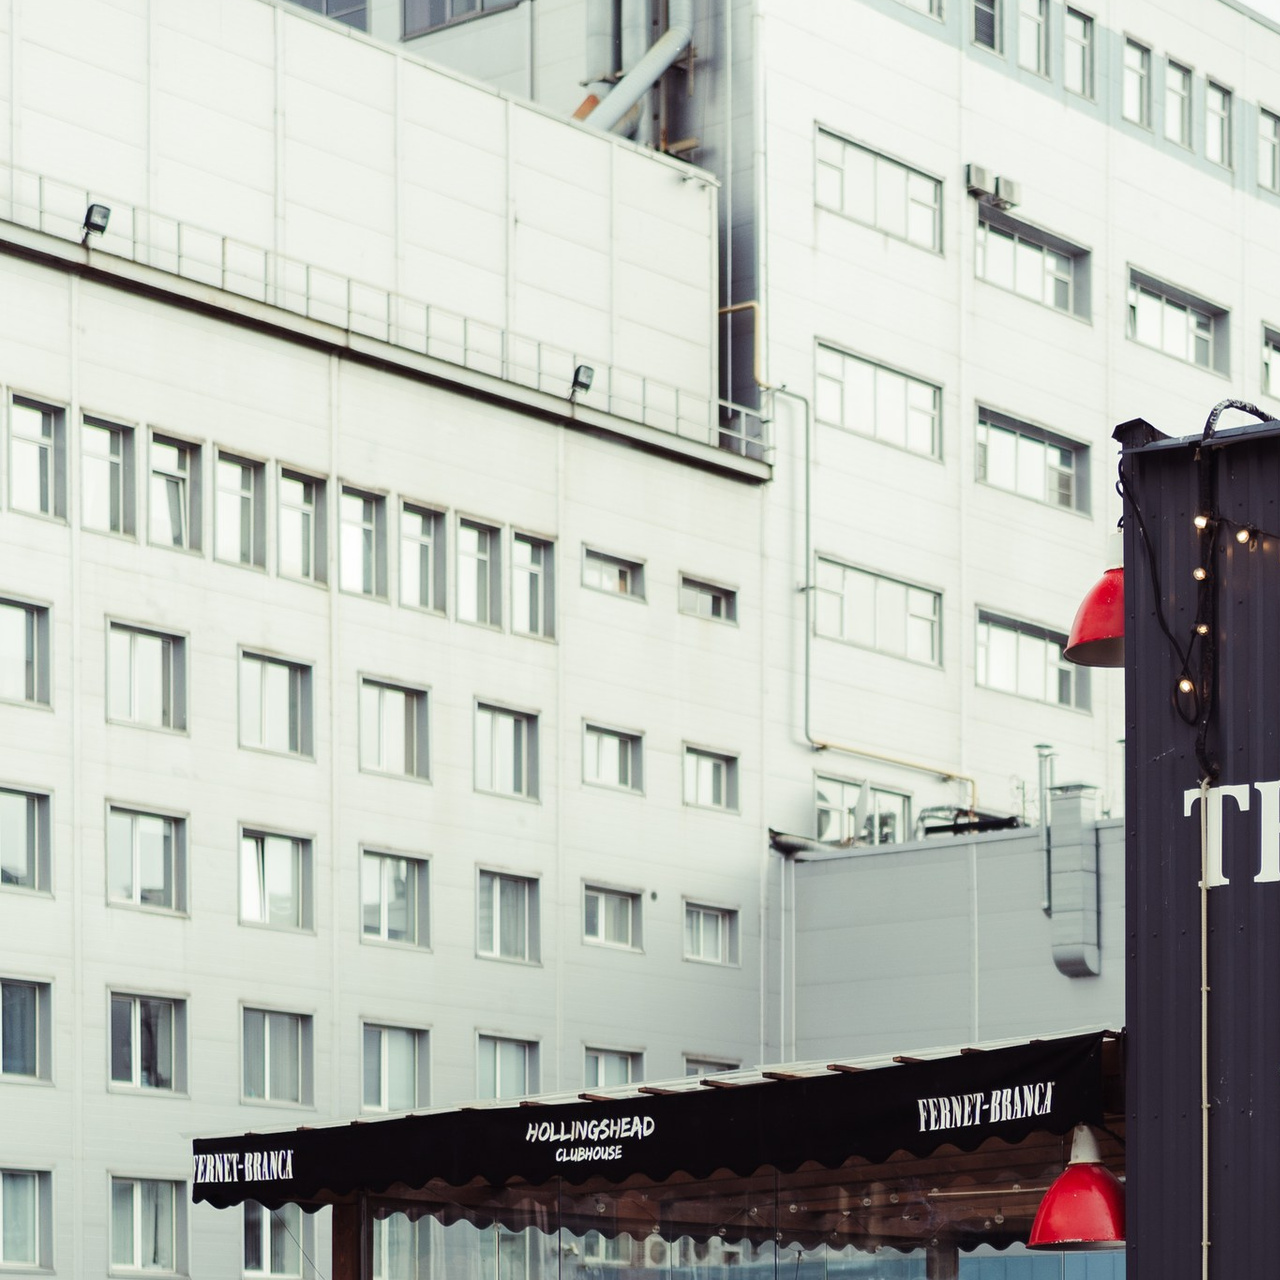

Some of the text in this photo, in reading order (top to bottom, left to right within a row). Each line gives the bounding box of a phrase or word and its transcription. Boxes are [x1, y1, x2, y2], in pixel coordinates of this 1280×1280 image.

[917, 1081, 1054, 1132] FERNET-BRANCA
[525, 1116, 655, 1142] HOLLINGSHEAD
[555, 1145, 623, 1162] CLUBHOUSE
